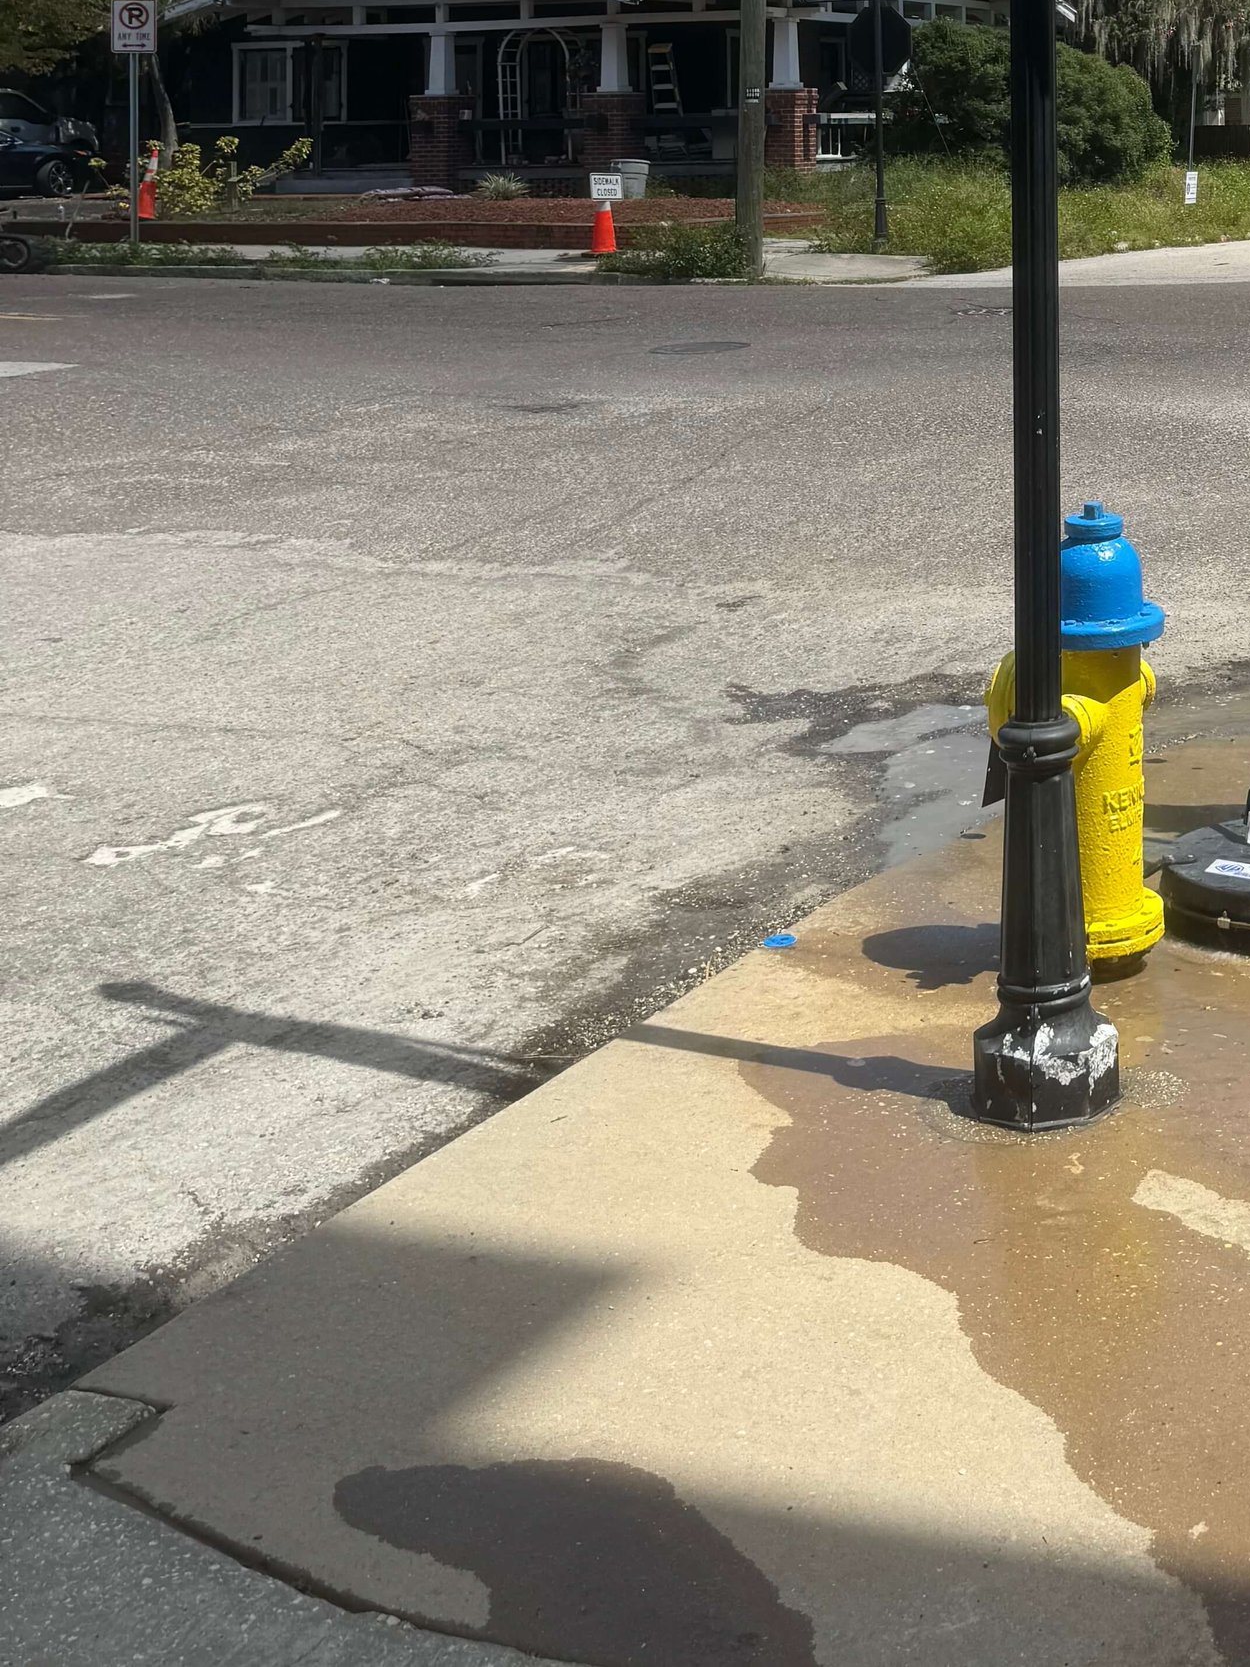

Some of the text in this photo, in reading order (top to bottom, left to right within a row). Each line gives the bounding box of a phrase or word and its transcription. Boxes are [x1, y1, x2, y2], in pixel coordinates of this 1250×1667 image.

[117, 32, 151, 41] ANY TIME
[593, 177, 620, 186] SIDEWALK
[596, 188, 618, 197] CLOSED
